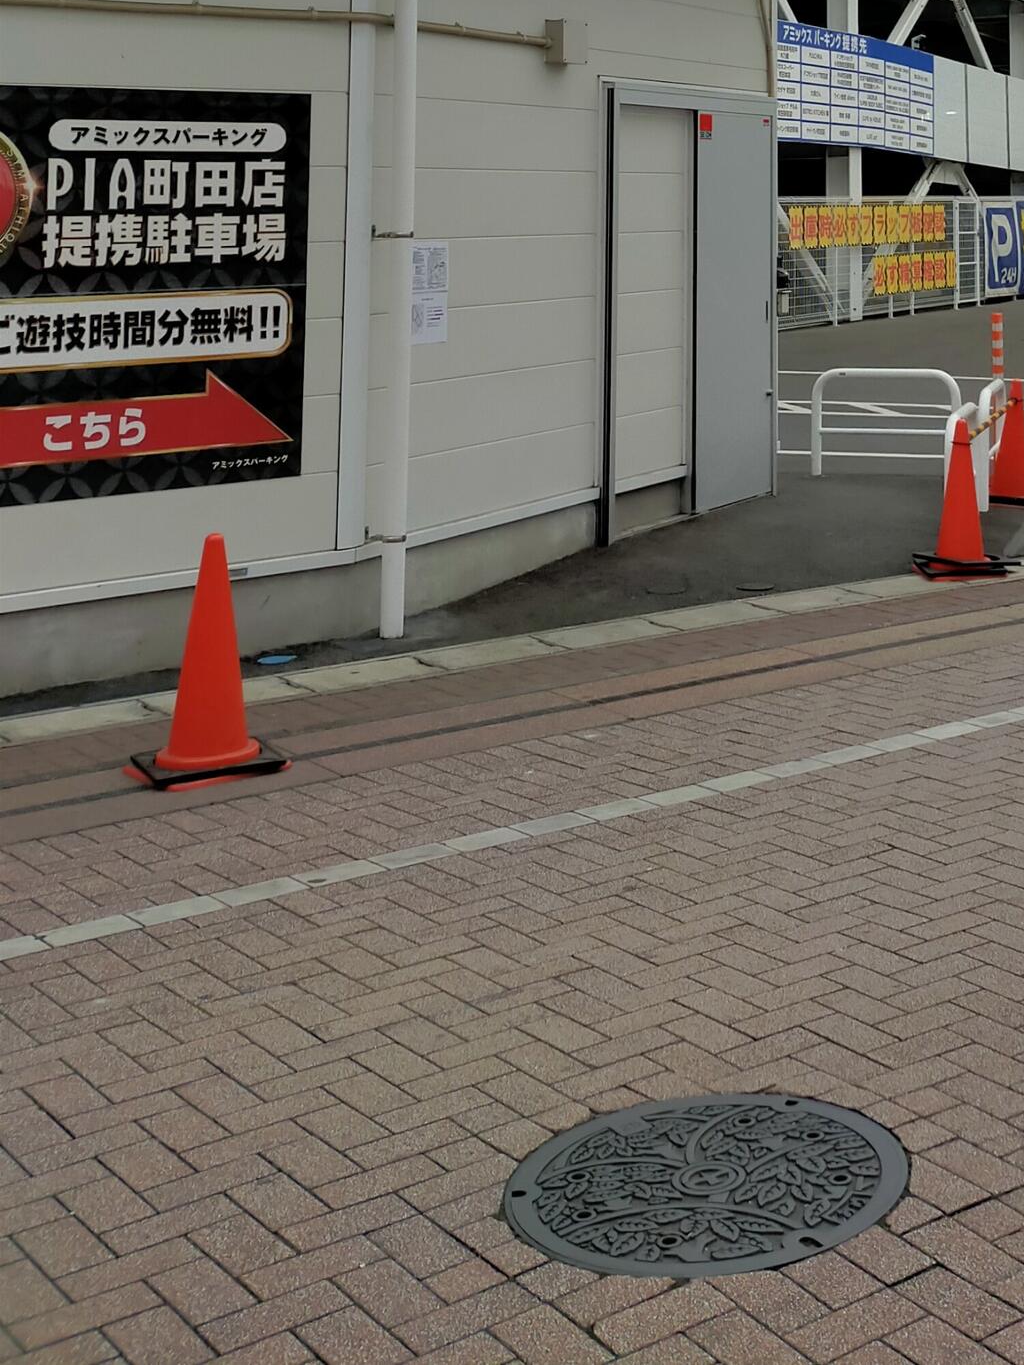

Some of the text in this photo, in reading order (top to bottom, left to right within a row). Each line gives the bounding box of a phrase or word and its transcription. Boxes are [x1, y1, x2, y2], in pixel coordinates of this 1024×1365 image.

[783, 25, 812, 44] アミックス
[71, 126, 268, 149] アミックスパーキング
[47, 157, 286, 211] PIA町田店
[42, 213, 286, 269] 提携駐車場
[991, 214, 1014, 283] P
[1000, 267, 1018, 284] 24H
[43, 408, 147, 452] こちら
[212, 454, 289, 470] アミックスパーキング
